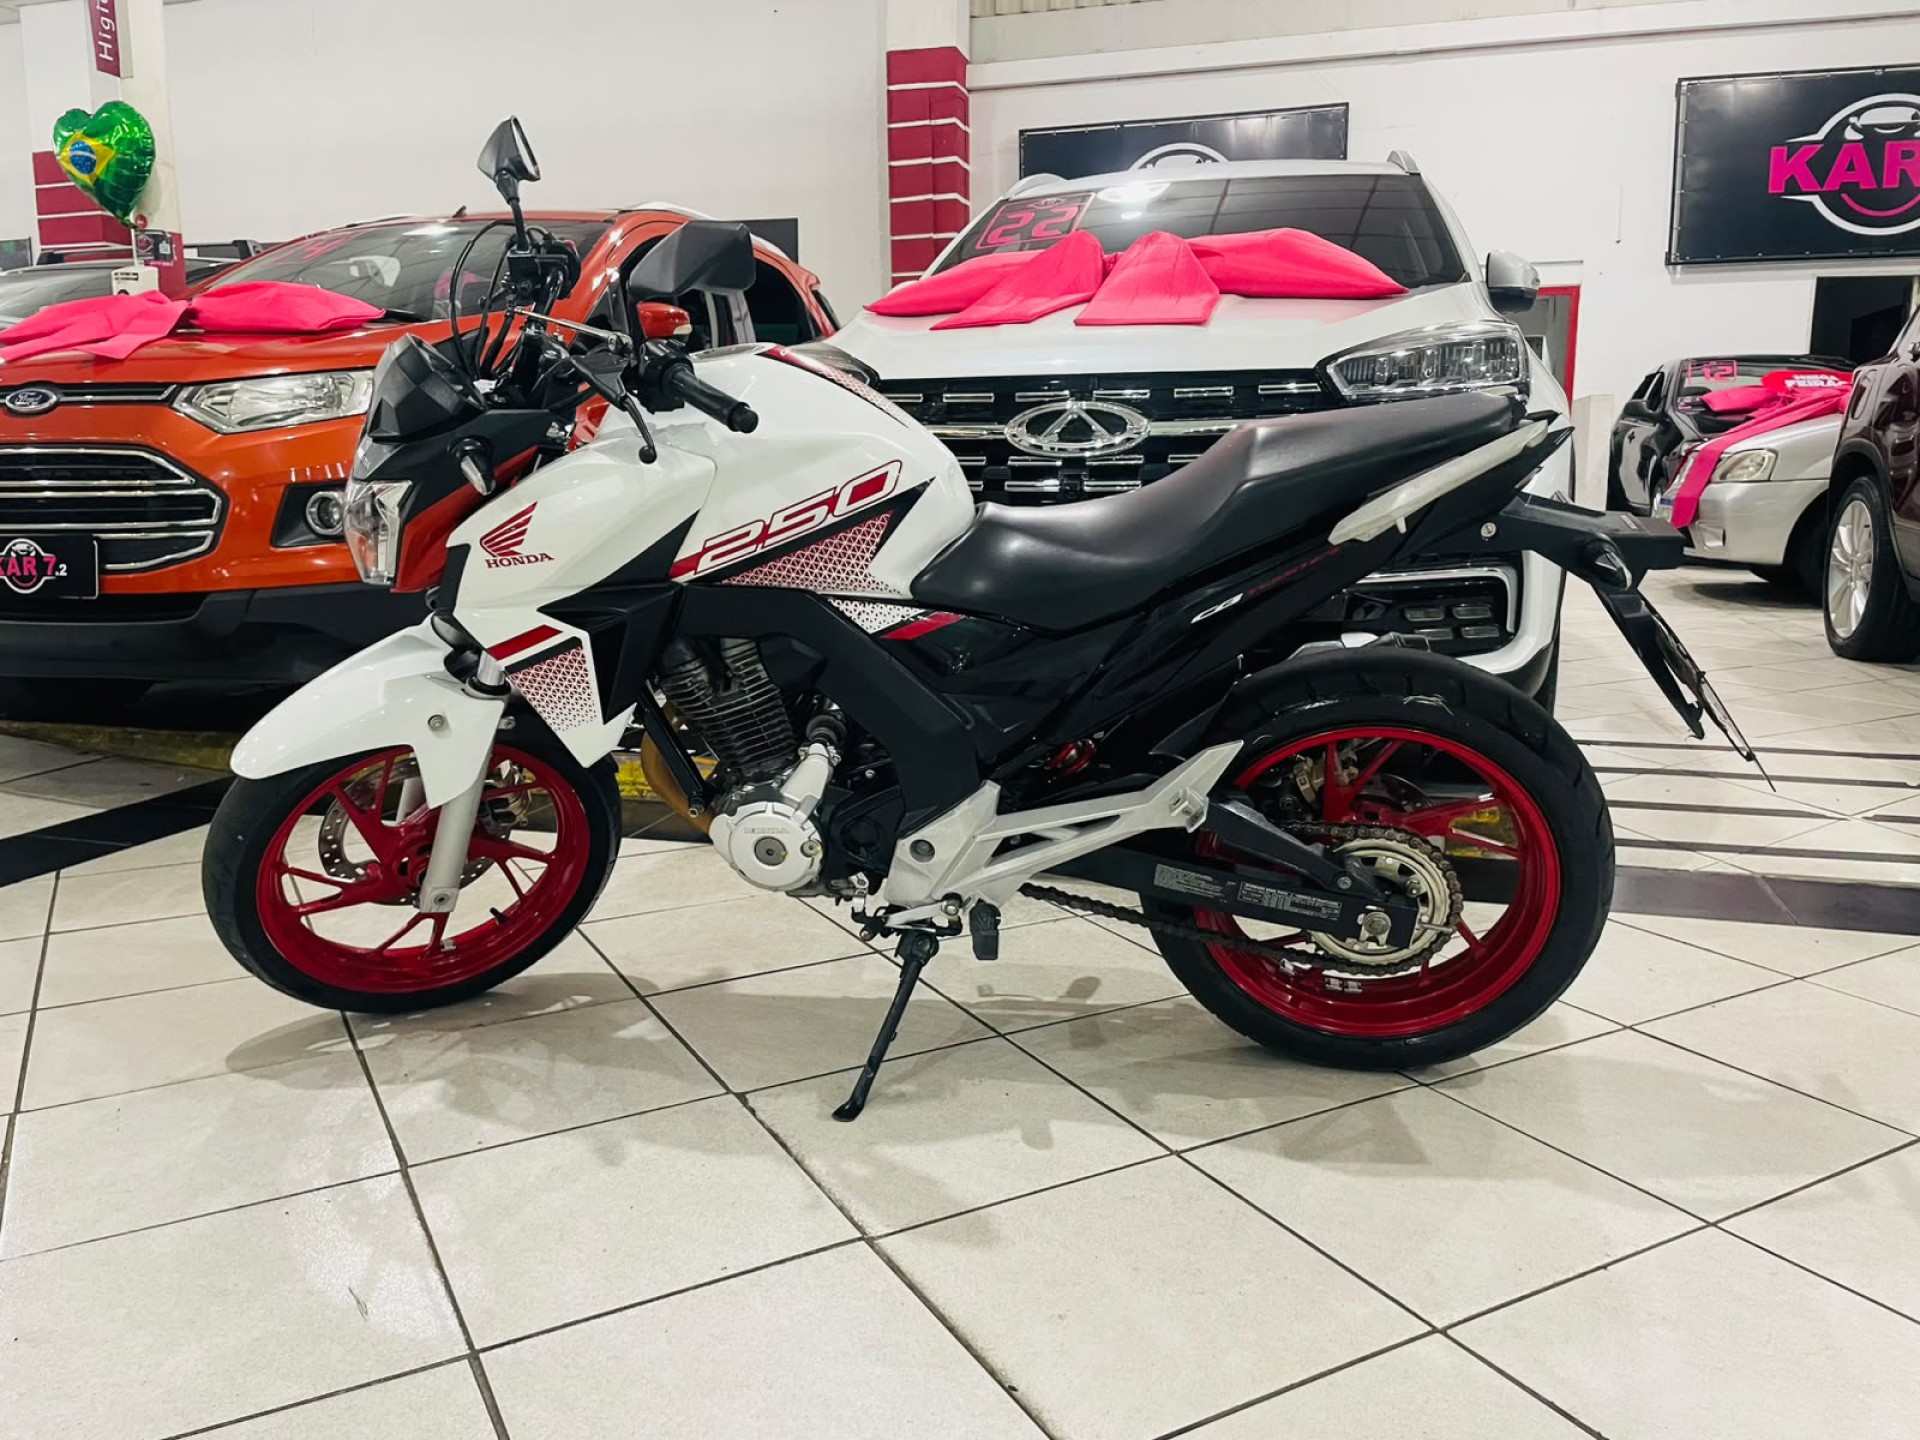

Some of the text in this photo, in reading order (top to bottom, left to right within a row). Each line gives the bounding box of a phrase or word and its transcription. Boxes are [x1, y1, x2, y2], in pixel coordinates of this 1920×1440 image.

[987, 206, 1079, 244] 22
[694, 459, 903, 575] 250
[485, 552, 555, 569] HONDA
